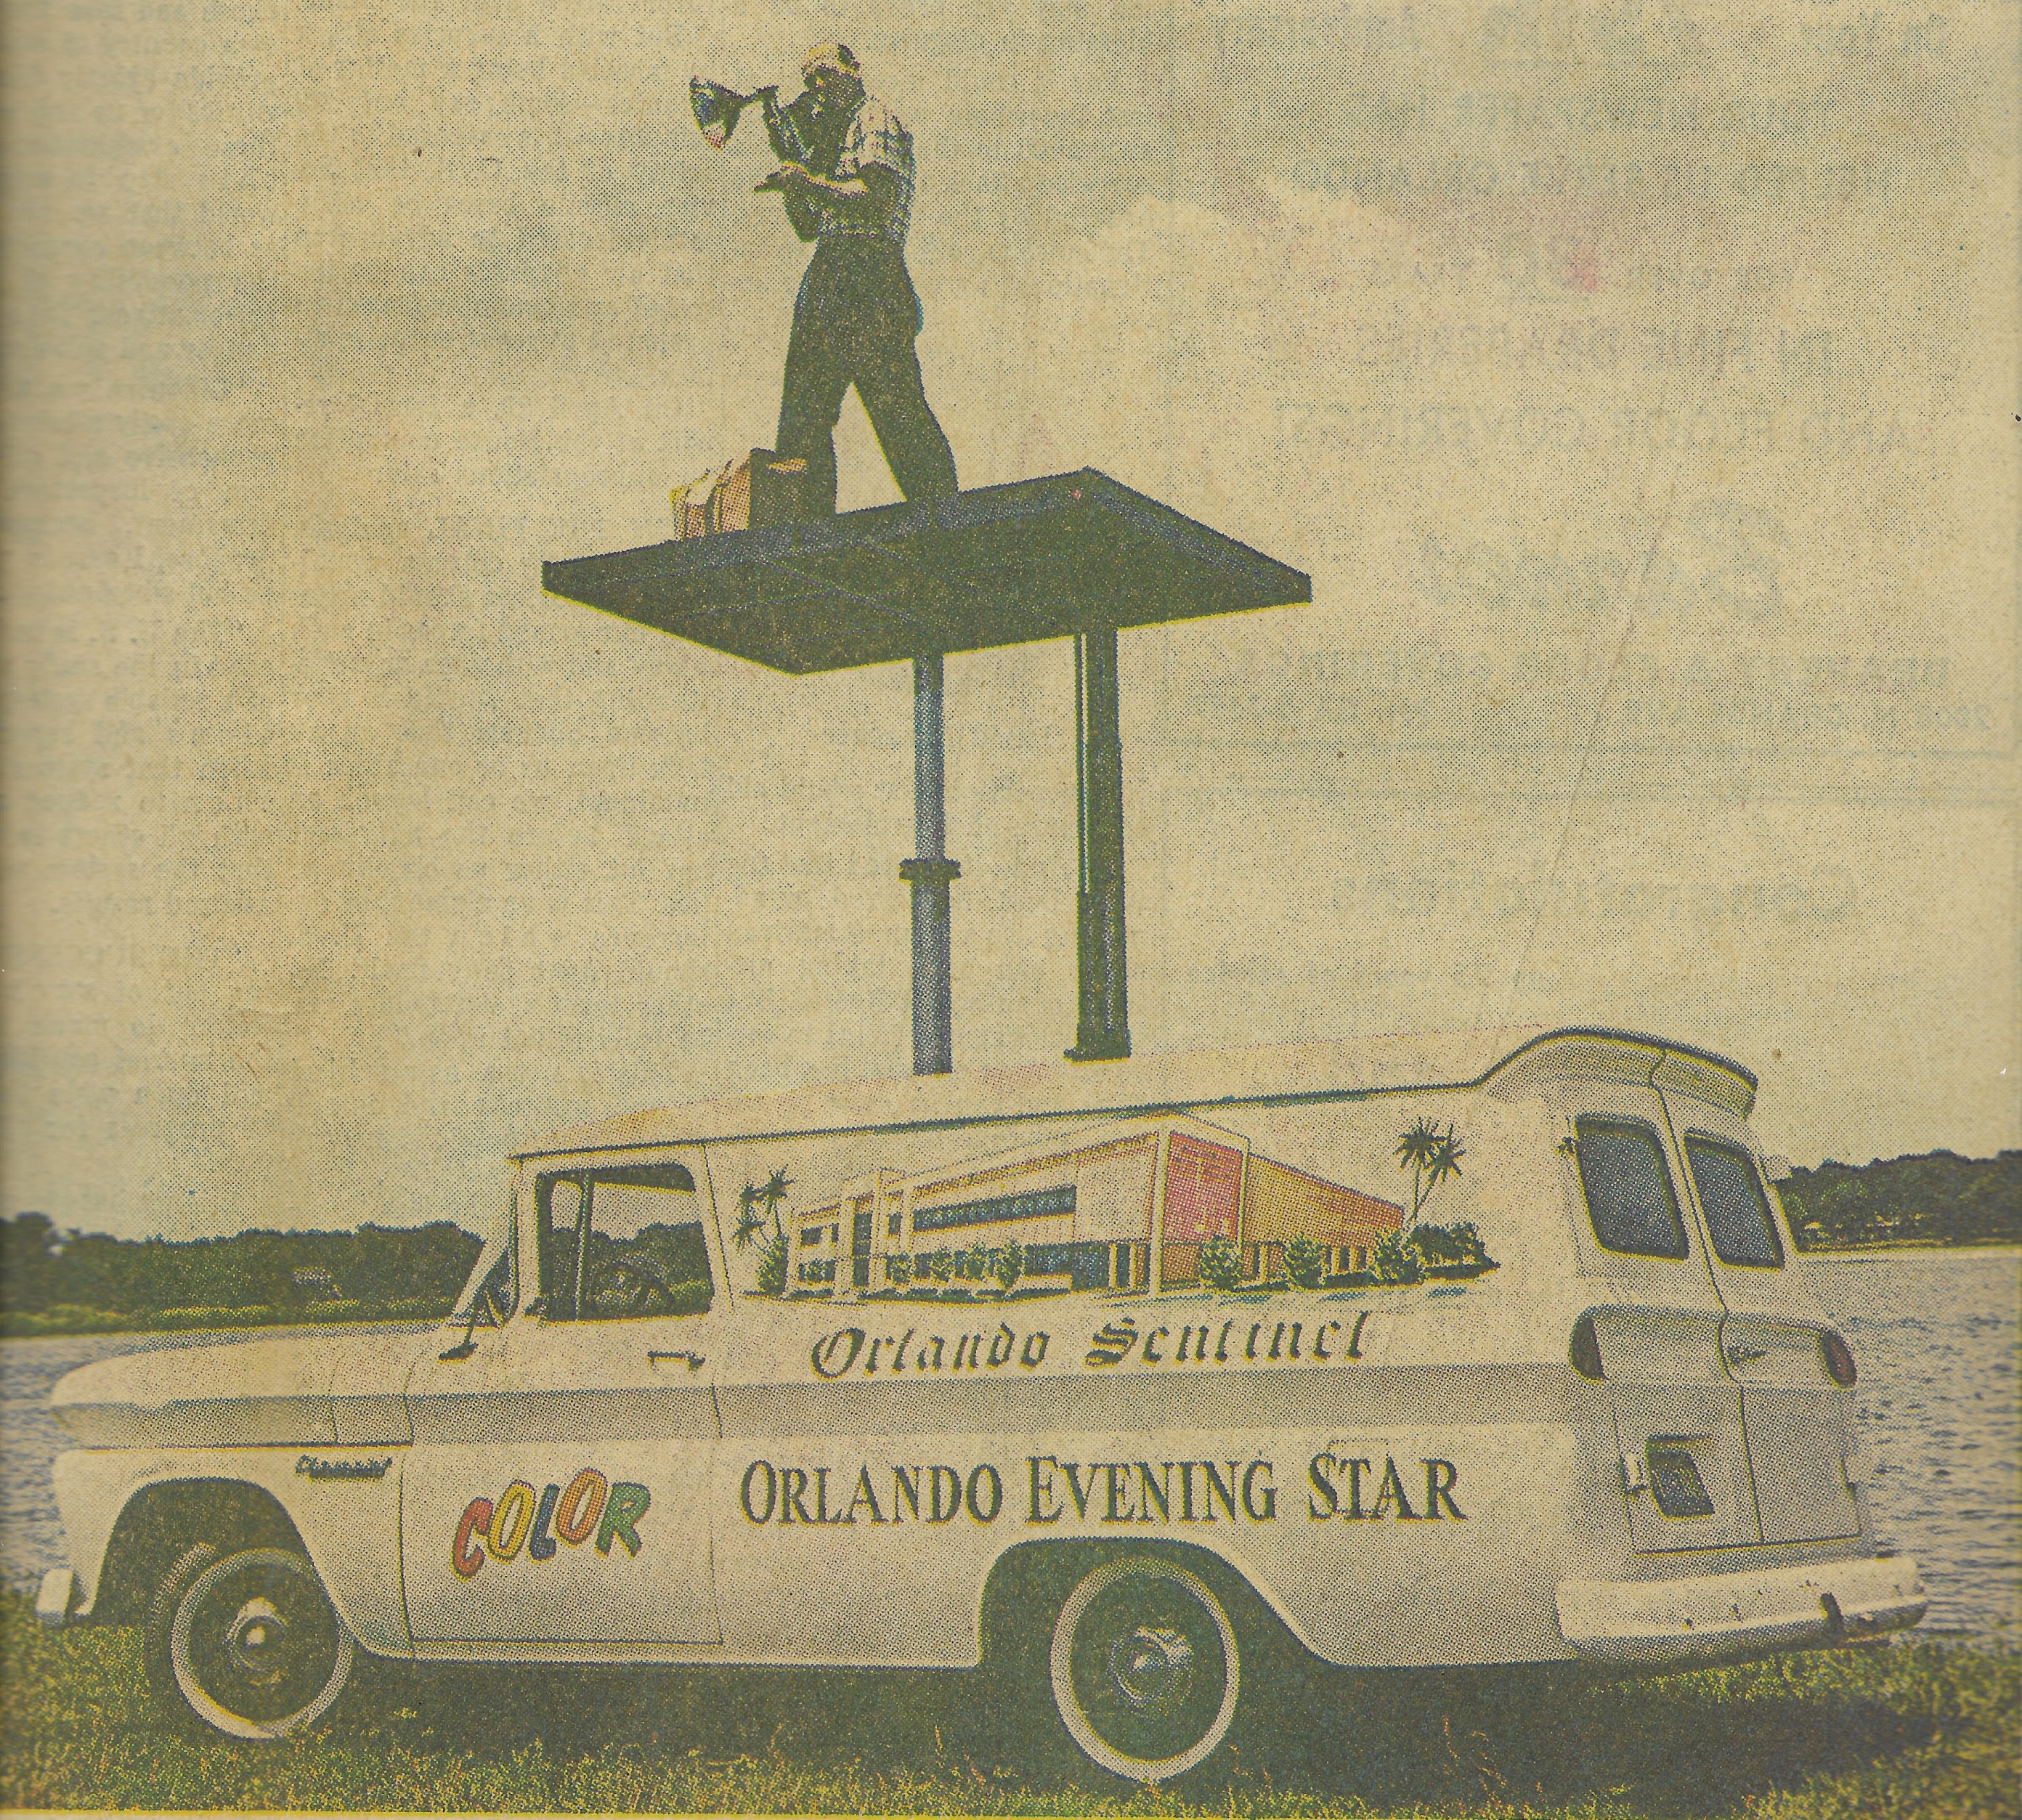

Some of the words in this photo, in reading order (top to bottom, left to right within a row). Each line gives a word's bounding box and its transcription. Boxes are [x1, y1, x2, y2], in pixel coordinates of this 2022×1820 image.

[811, 1323, 1050, 1380] Orlando
[1084, 1310, 1371, 1369] Sentinel
[451, 1468, 651, 1581] COLOR
[739, 1459, 1004, 1526] ORLANDO
[1023, 1454, 1278, 1526] EVENING
[1307, 1453, 1470, 1523] STAR
